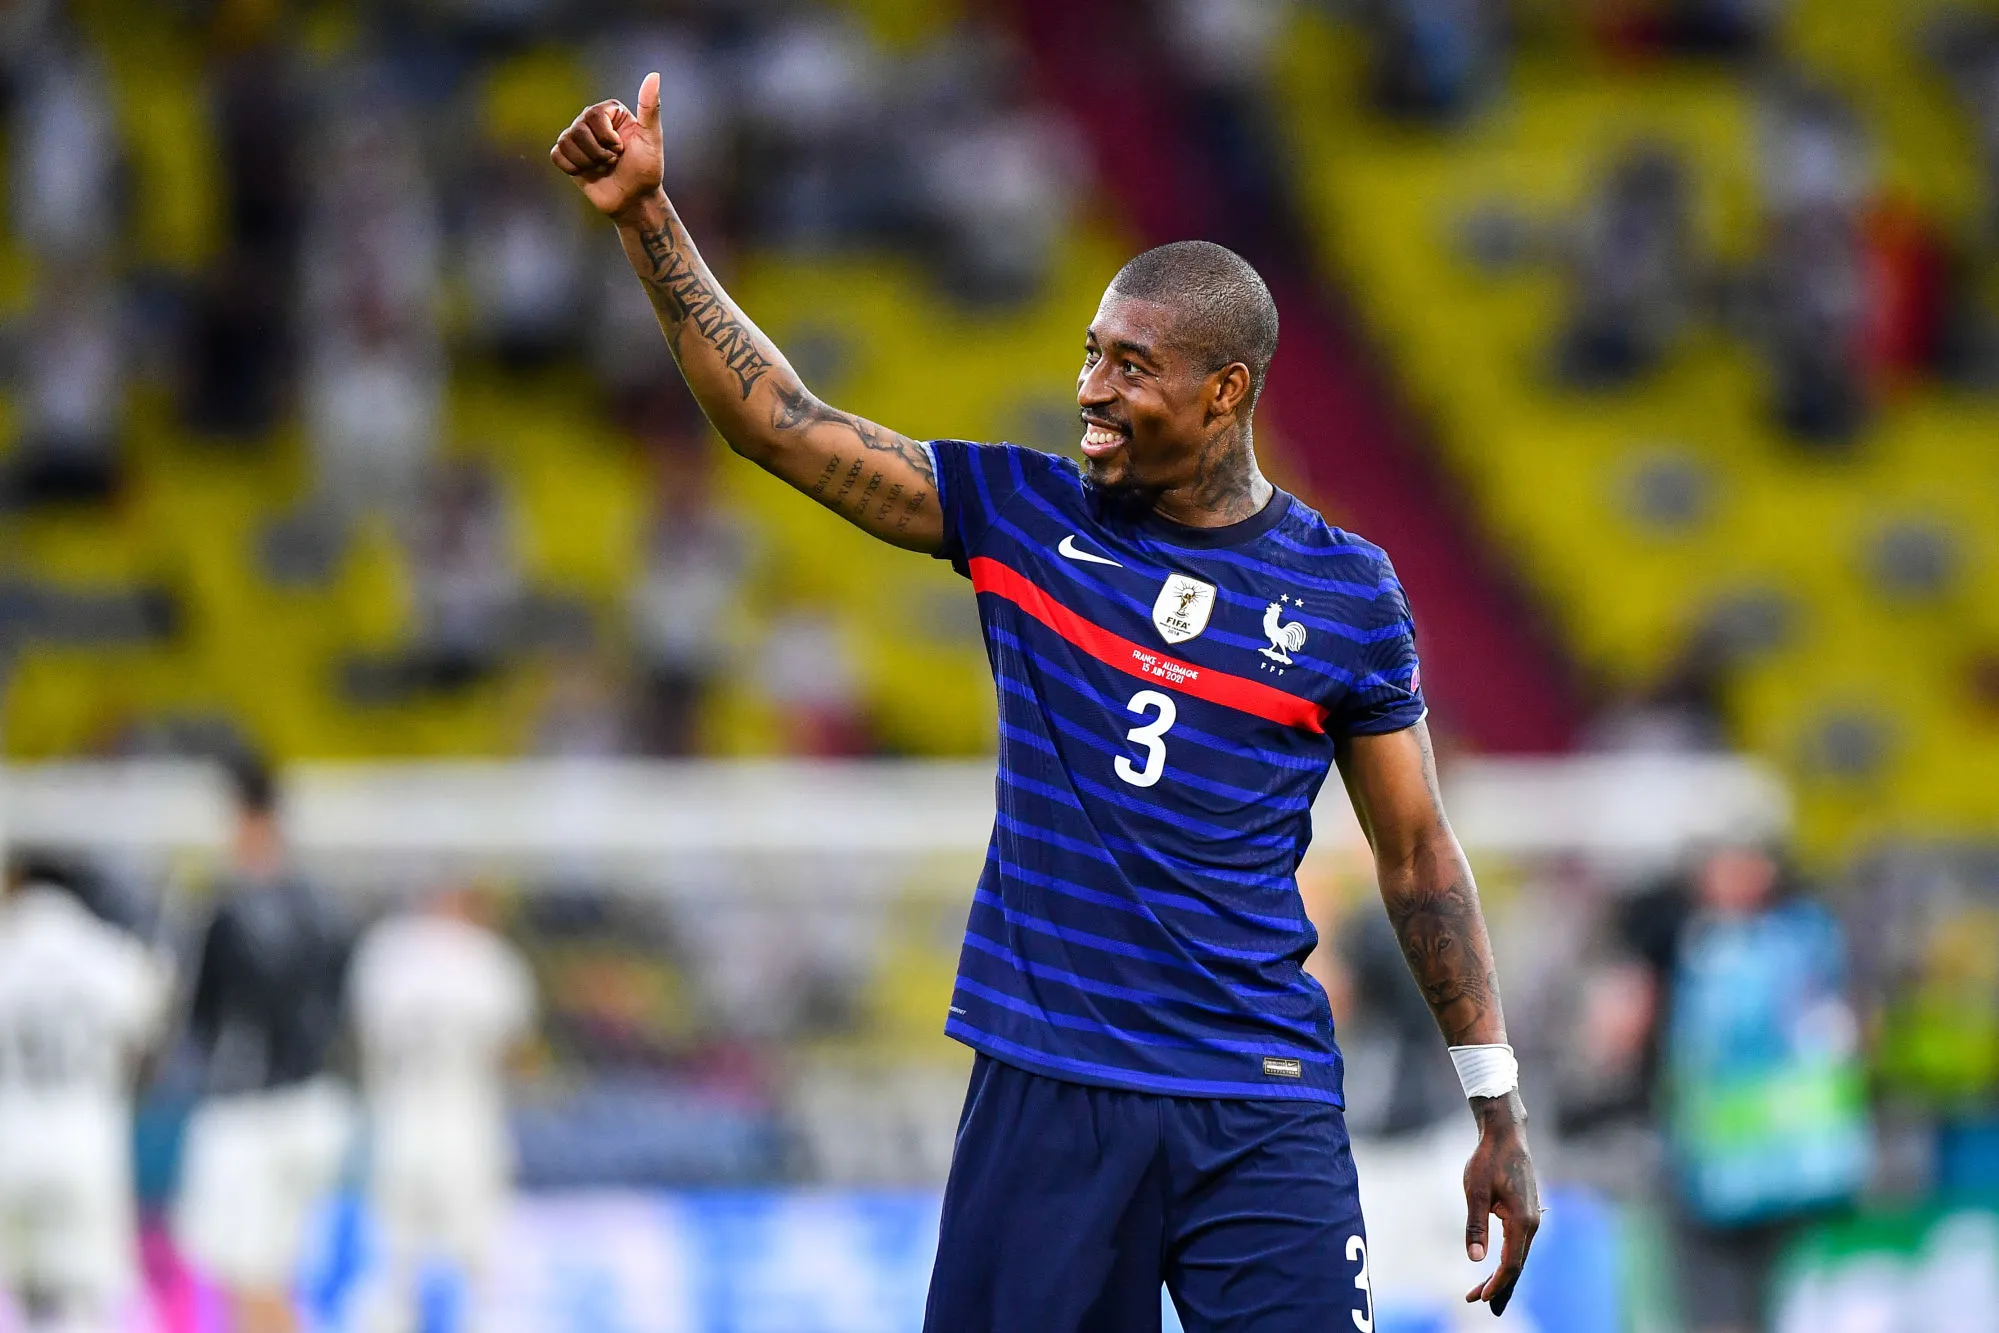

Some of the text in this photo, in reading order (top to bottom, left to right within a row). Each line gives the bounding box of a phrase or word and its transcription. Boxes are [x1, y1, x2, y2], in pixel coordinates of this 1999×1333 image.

[641, 218, 773, 401] EVELYNE
[1166, 617, 1188, 630] FIFA
[1132, 650, 1157, 665] FRANCE
[1162, 662, 1198, 680] ALLEMAGNE
[1142, 663, 1185, 684] 15 JUIN 2021
[1113, 689, 1177, 788] 3
[1345, 1235, 1374, 1333] 3
